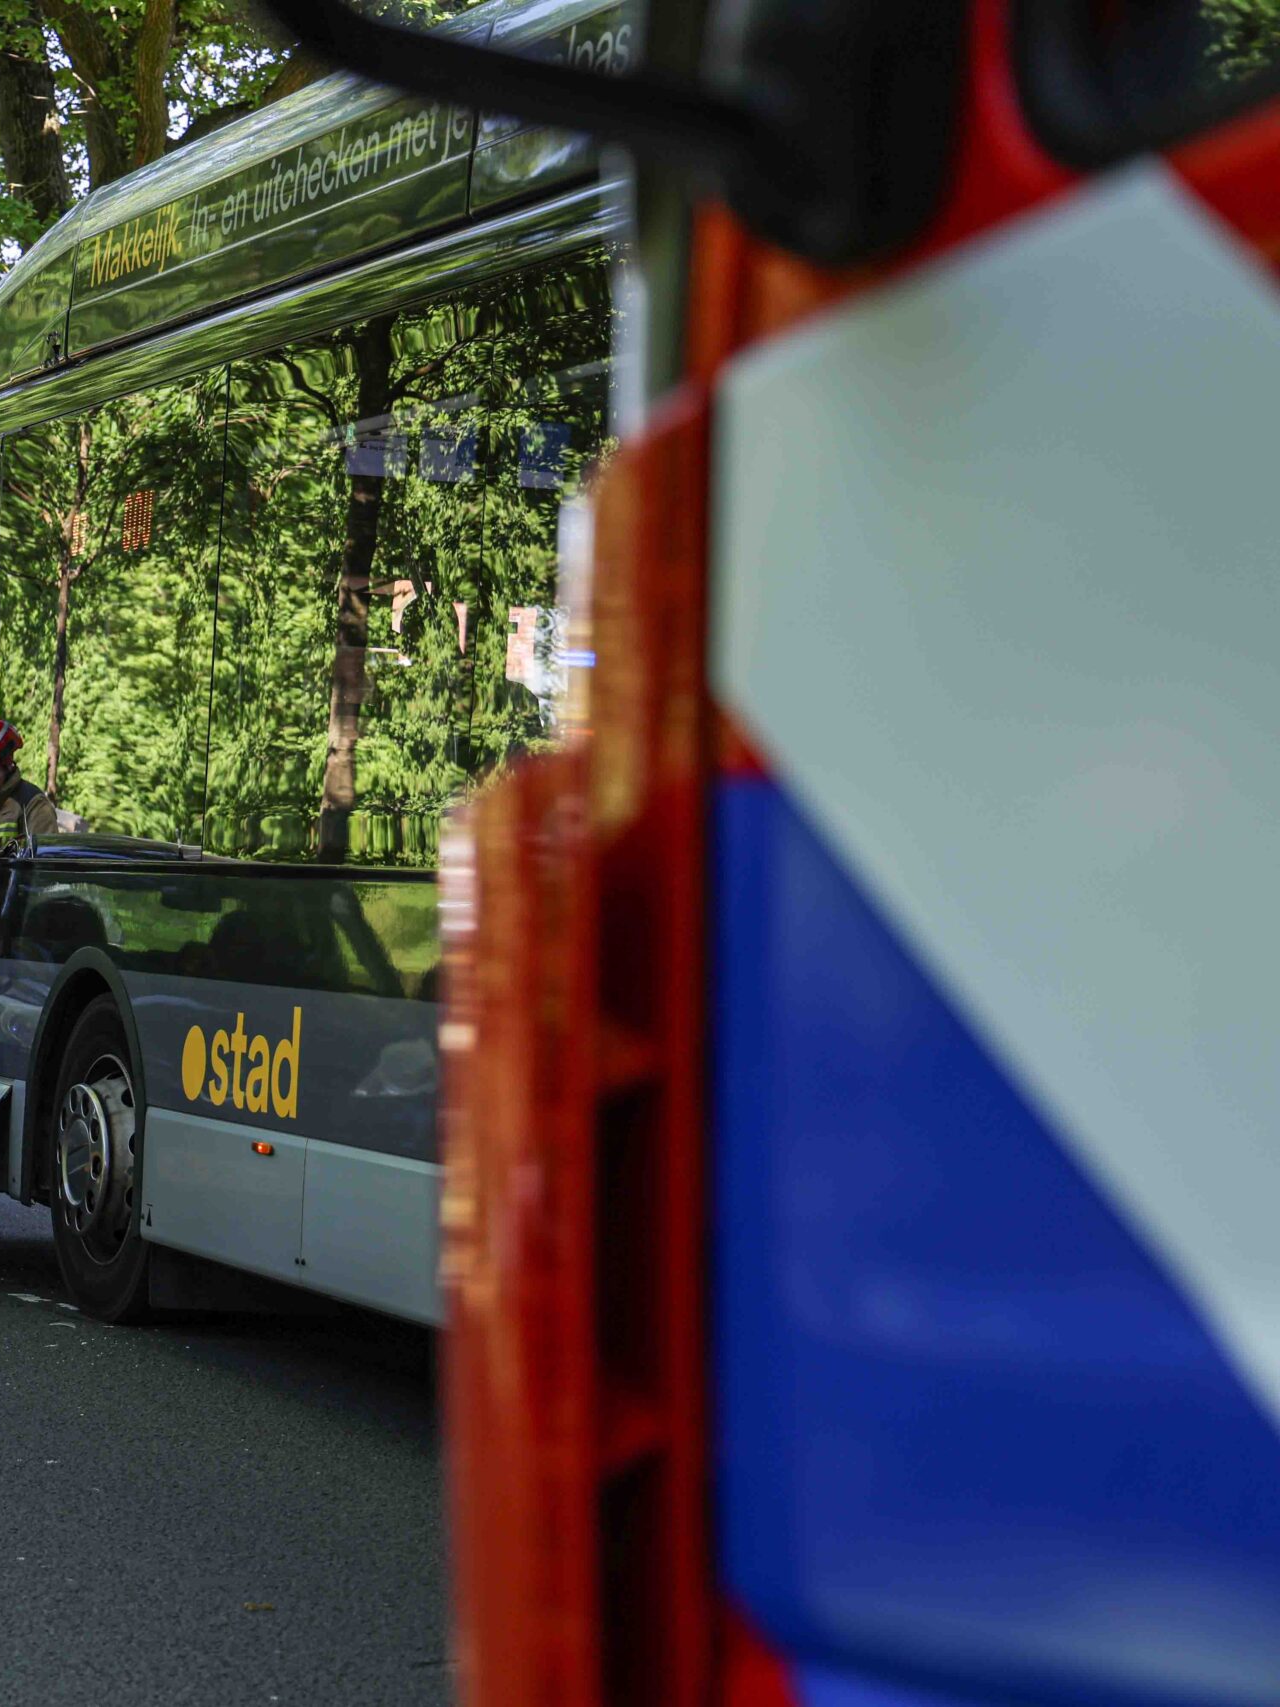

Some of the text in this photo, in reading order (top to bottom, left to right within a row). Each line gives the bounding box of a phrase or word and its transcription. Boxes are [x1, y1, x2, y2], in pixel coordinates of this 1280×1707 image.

[90, 202, 182, 288] Makkelijk.
[189, 194, 217, 249] In-
[222, 188, 248, 235] en
[253, 127, 381, 223] uitchecken
[386, 103, 440, 169] met
[208, 1006, 302, 1119] stad
